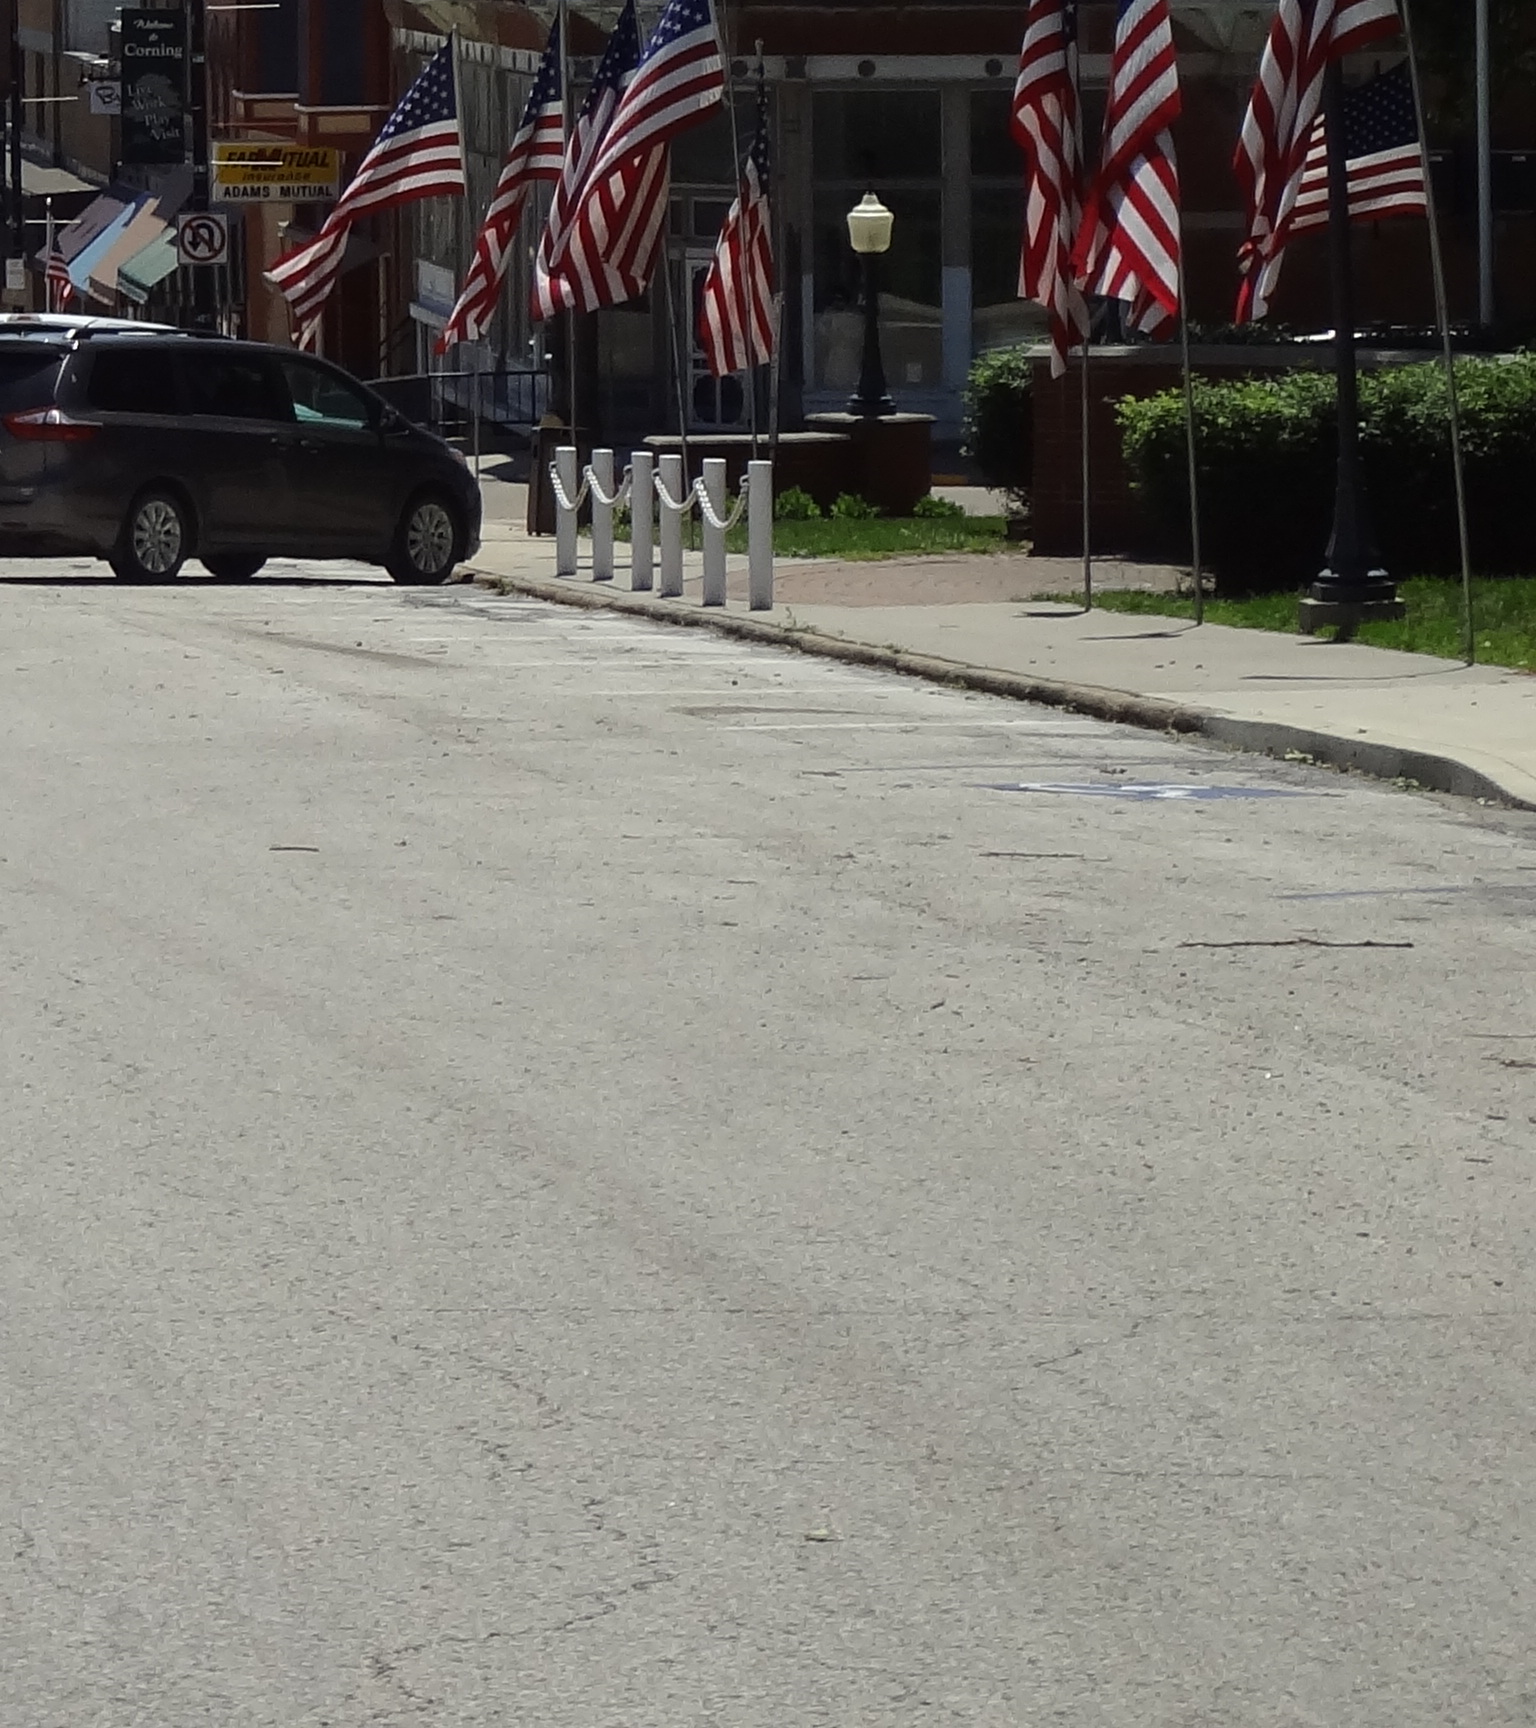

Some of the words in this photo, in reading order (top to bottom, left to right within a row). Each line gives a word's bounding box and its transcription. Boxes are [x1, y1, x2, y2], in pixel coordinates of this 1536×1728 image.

[124, 43, 184, 59] Corning
[128, 84, 153, 97] Live
[151, 128, 182, 141] Visit
[223, 185, 271, 198] ADAMS
[279, 185, 334, 198] MUTUAL
